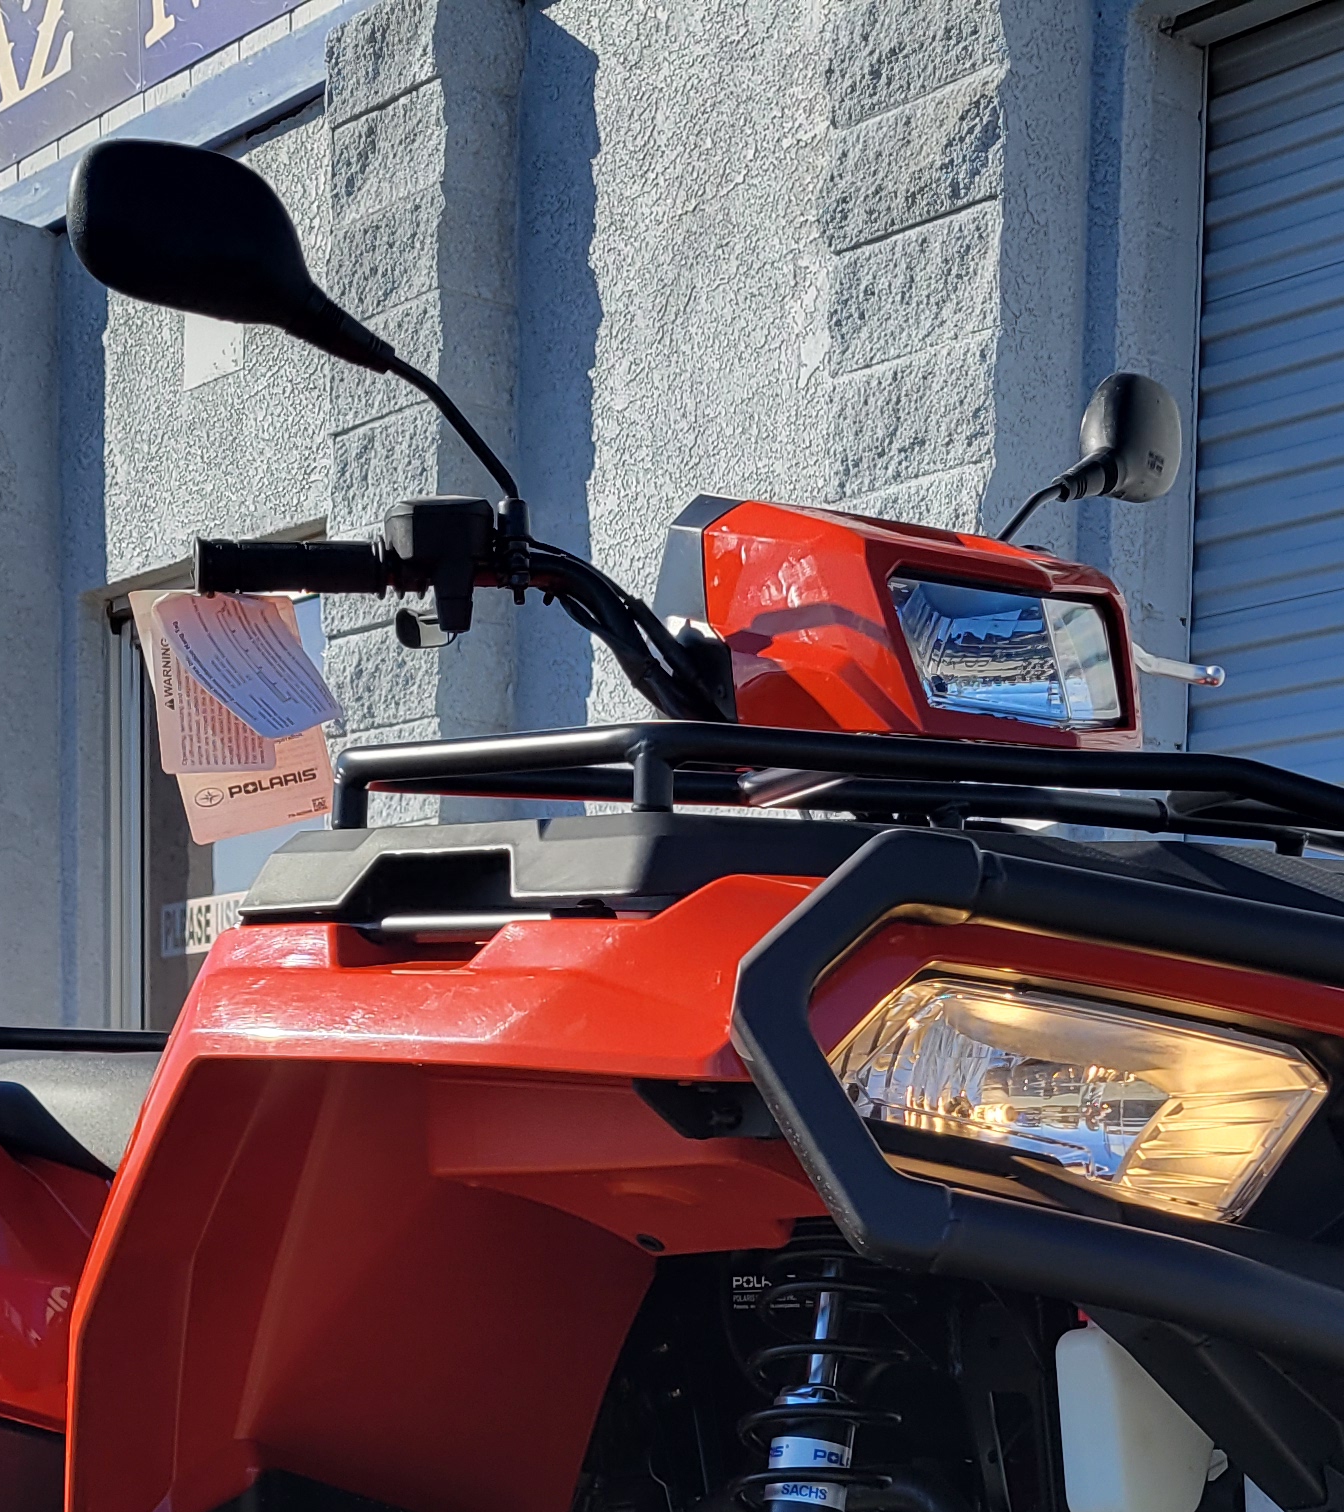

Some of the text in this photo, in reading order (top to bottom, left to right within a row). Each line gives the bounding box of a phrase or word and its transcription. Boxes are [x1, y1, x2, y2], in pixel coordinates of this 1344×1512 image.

[161, 638, 173, 698] WARNING
[228, 768, 317, 798] POLARIS
[164, 905, 211, 951] PLEASE
[781, 1484, 828, 1500] SACHS
